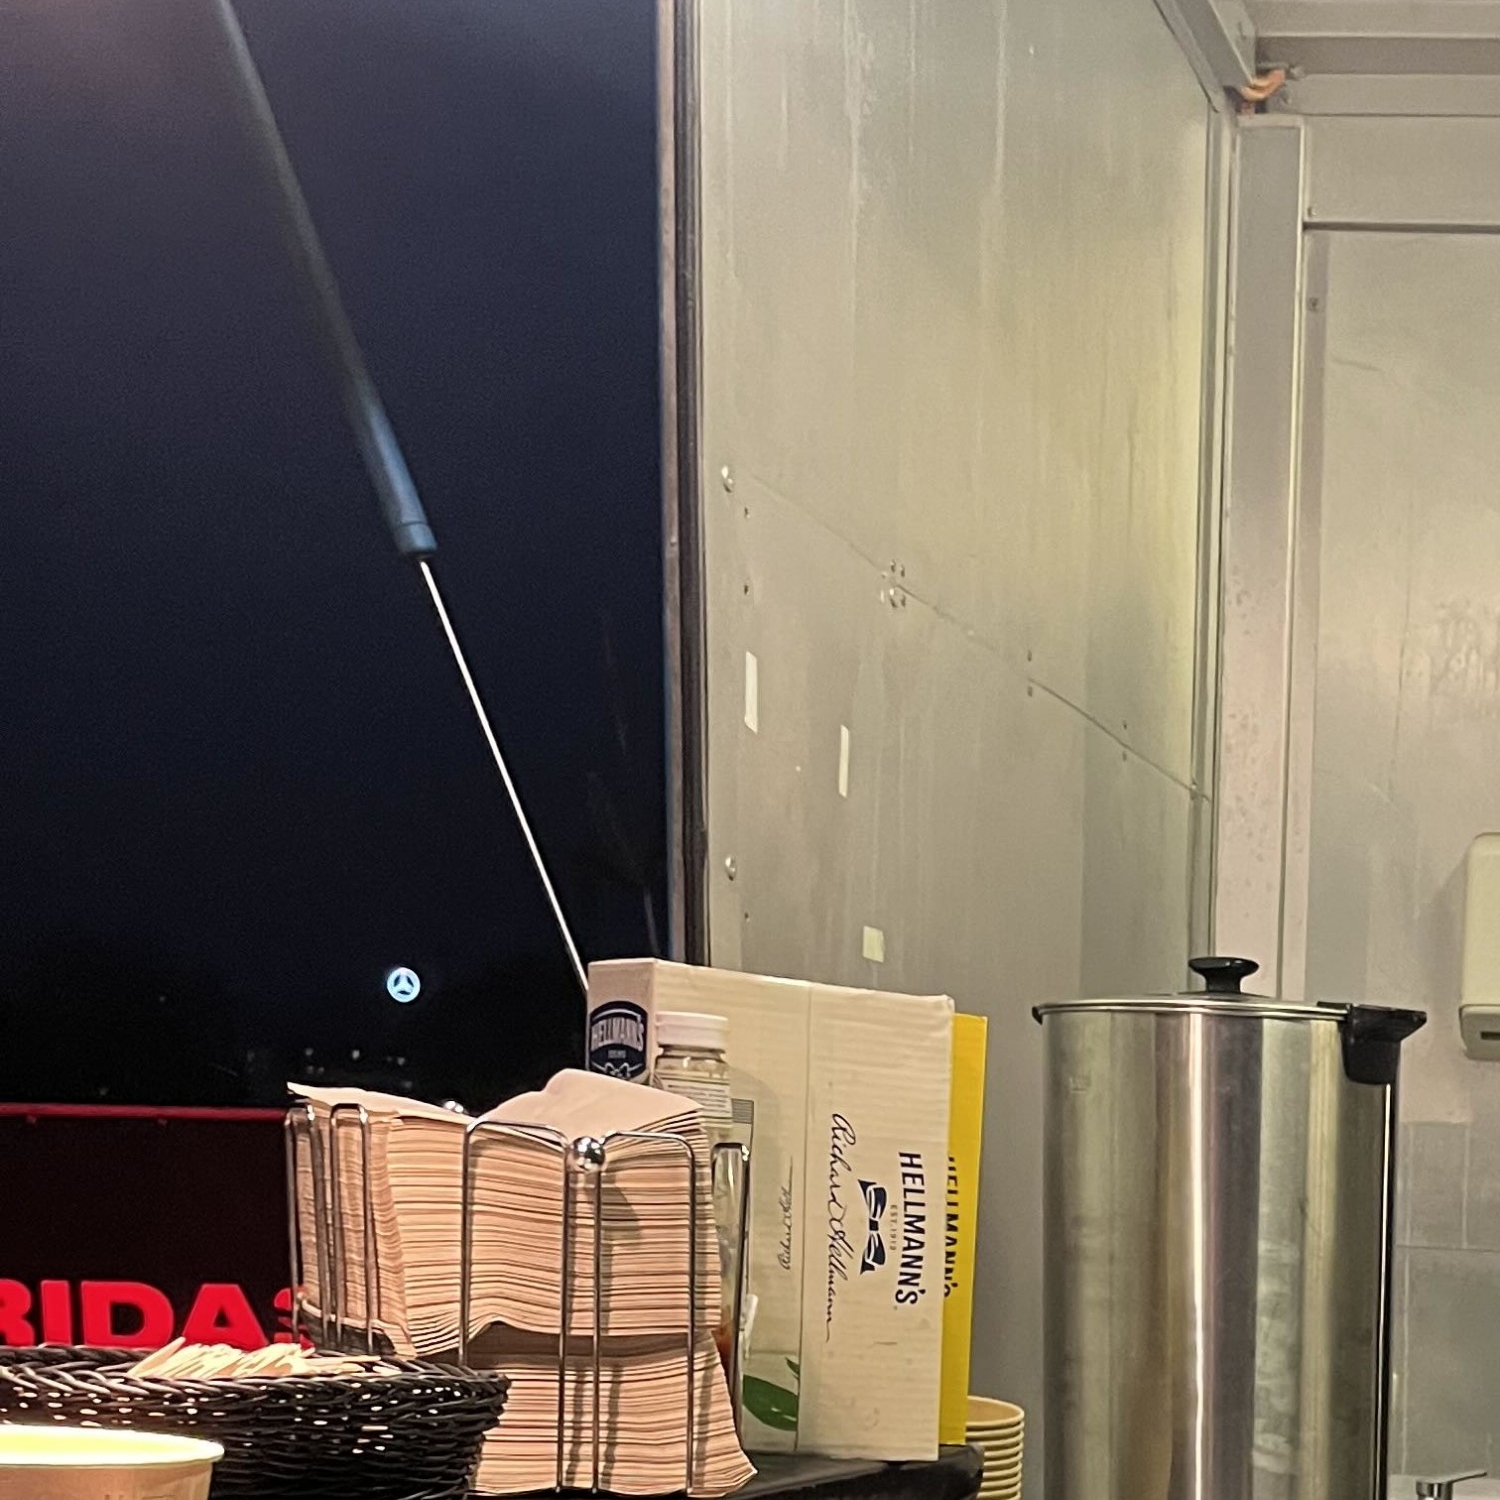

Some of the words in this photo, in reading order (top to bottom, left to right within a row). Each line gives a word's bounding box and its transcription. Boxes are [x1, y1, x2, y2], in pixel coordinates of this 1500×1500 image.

[828, 1113, 857, 1218] Richard
[894, 1151, 928, 1305] HELLMANN'S
[825, 1215, 855, 1343] Hellmann
